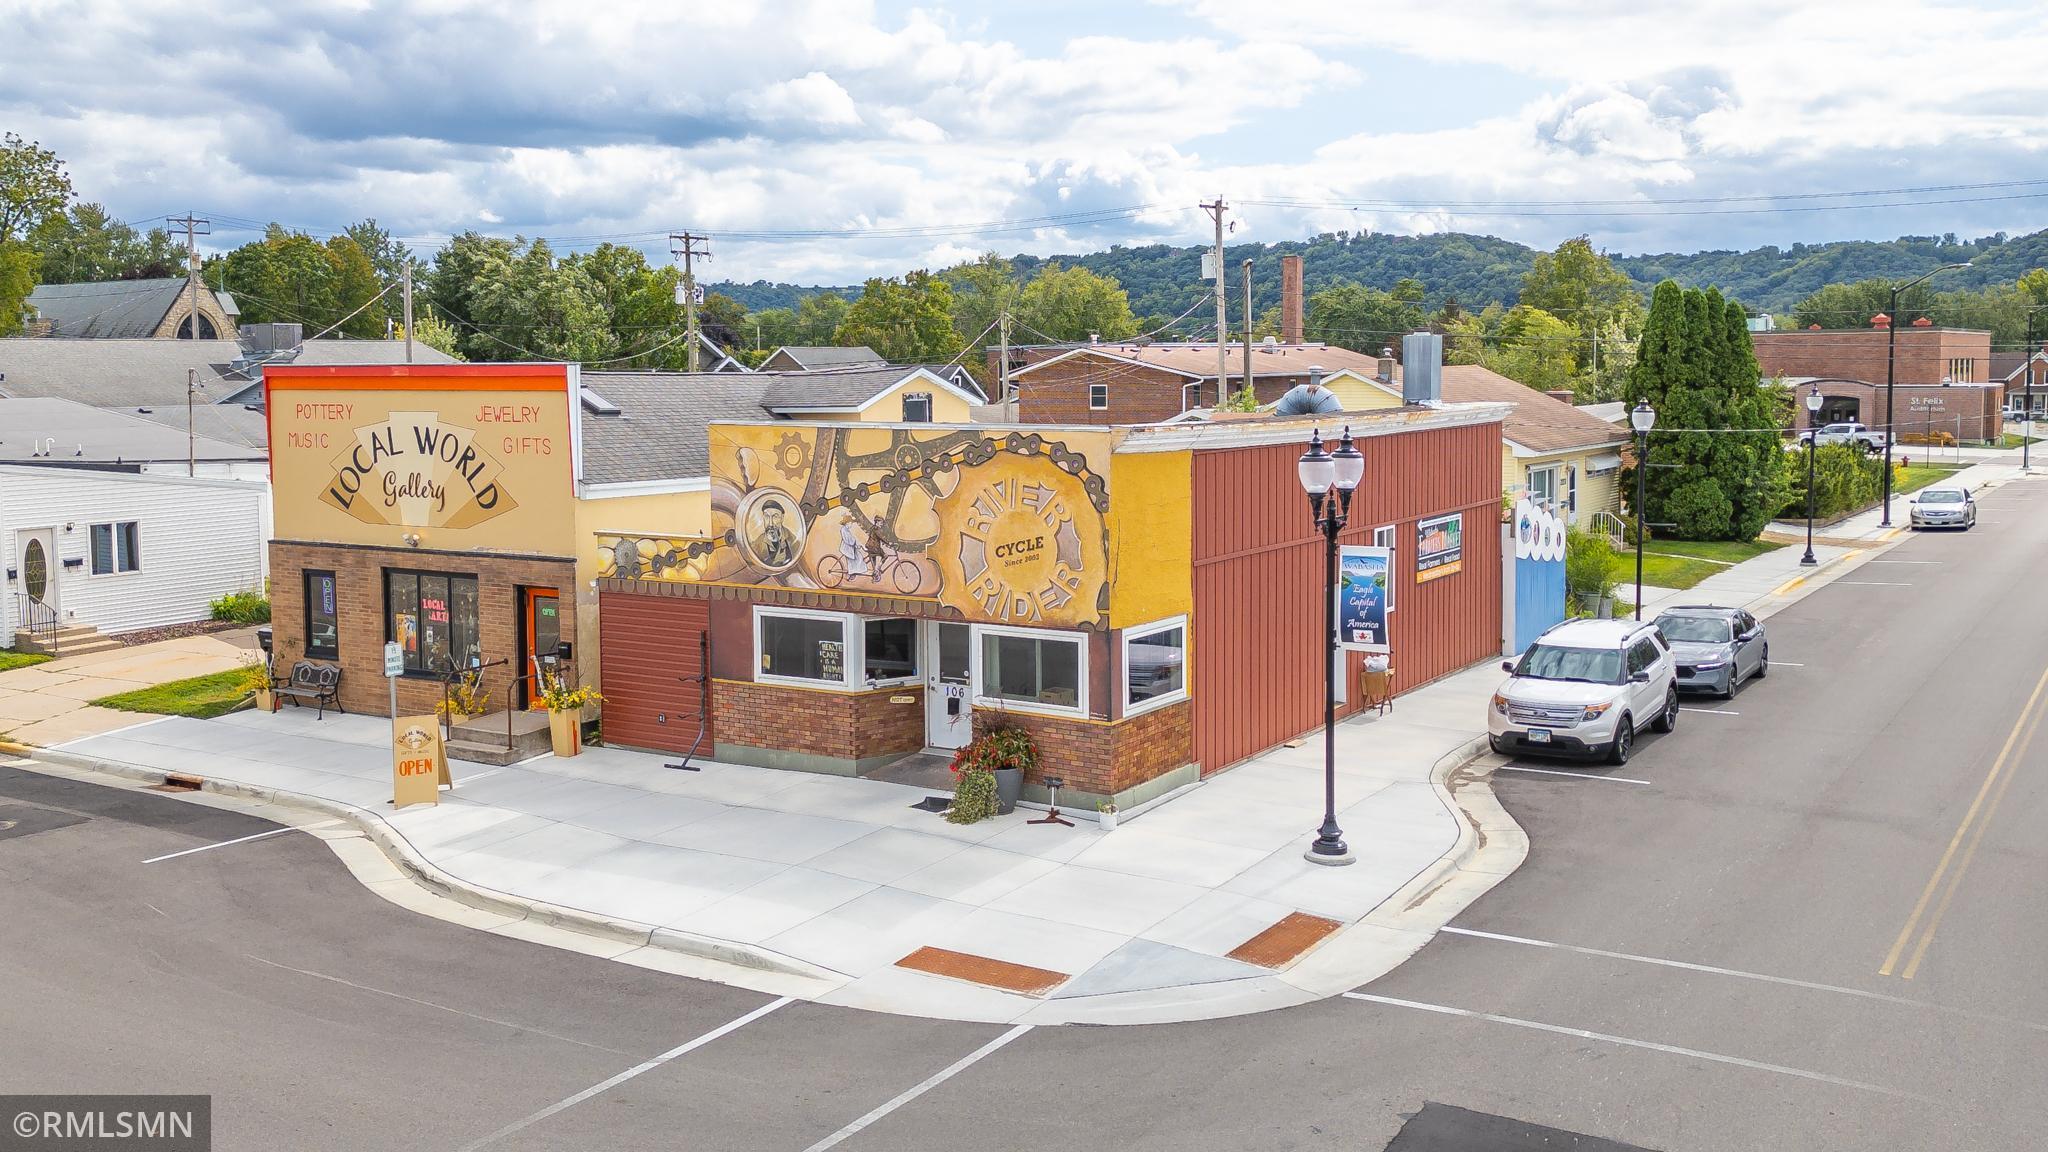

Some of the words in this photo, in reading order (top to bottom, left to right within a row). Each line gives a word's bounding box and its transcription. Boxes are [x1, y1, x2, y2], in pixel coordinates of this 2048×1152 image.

[1923, 397, 1944, 405] Felix
[296, 403, 354, 421] POTTERY
[475, 405, 541, 423] JEWELRY
[288, 432, 329, 449] MUSIC
[503, 437, 552, 455] GIFTS
[330, 426, 404, 510] LOCAL
[413, 425, 499, 510] WORLD
[382, 470, 446, 513] Gallery
[960, 477, 1075, 541] RIVER
[995, 535, 1044, 558] CYCLE
[1004, 559, 1023, 568] Since
[1344, 563, 1384, 571] WABASHA
[966, 562, 1081, 622] RIDER
[1353, 583, 1374, 598] Eagle
[422, 598, 446, 611] LOCAL
[1349, 596, 1378, 610] Capital
[542, 607, 556, 617] OPEN
[1359, 606, 1369, 619] of
[1347, 619, 1379, 629] America
[822, 650, 839, 659] CARE
[945, 685, 965, 698] 106
[398, 730, 415, 744] LOCAL
[416, 729, 432, 742] WORLD
[398, 758, 433, 777] OPEN
